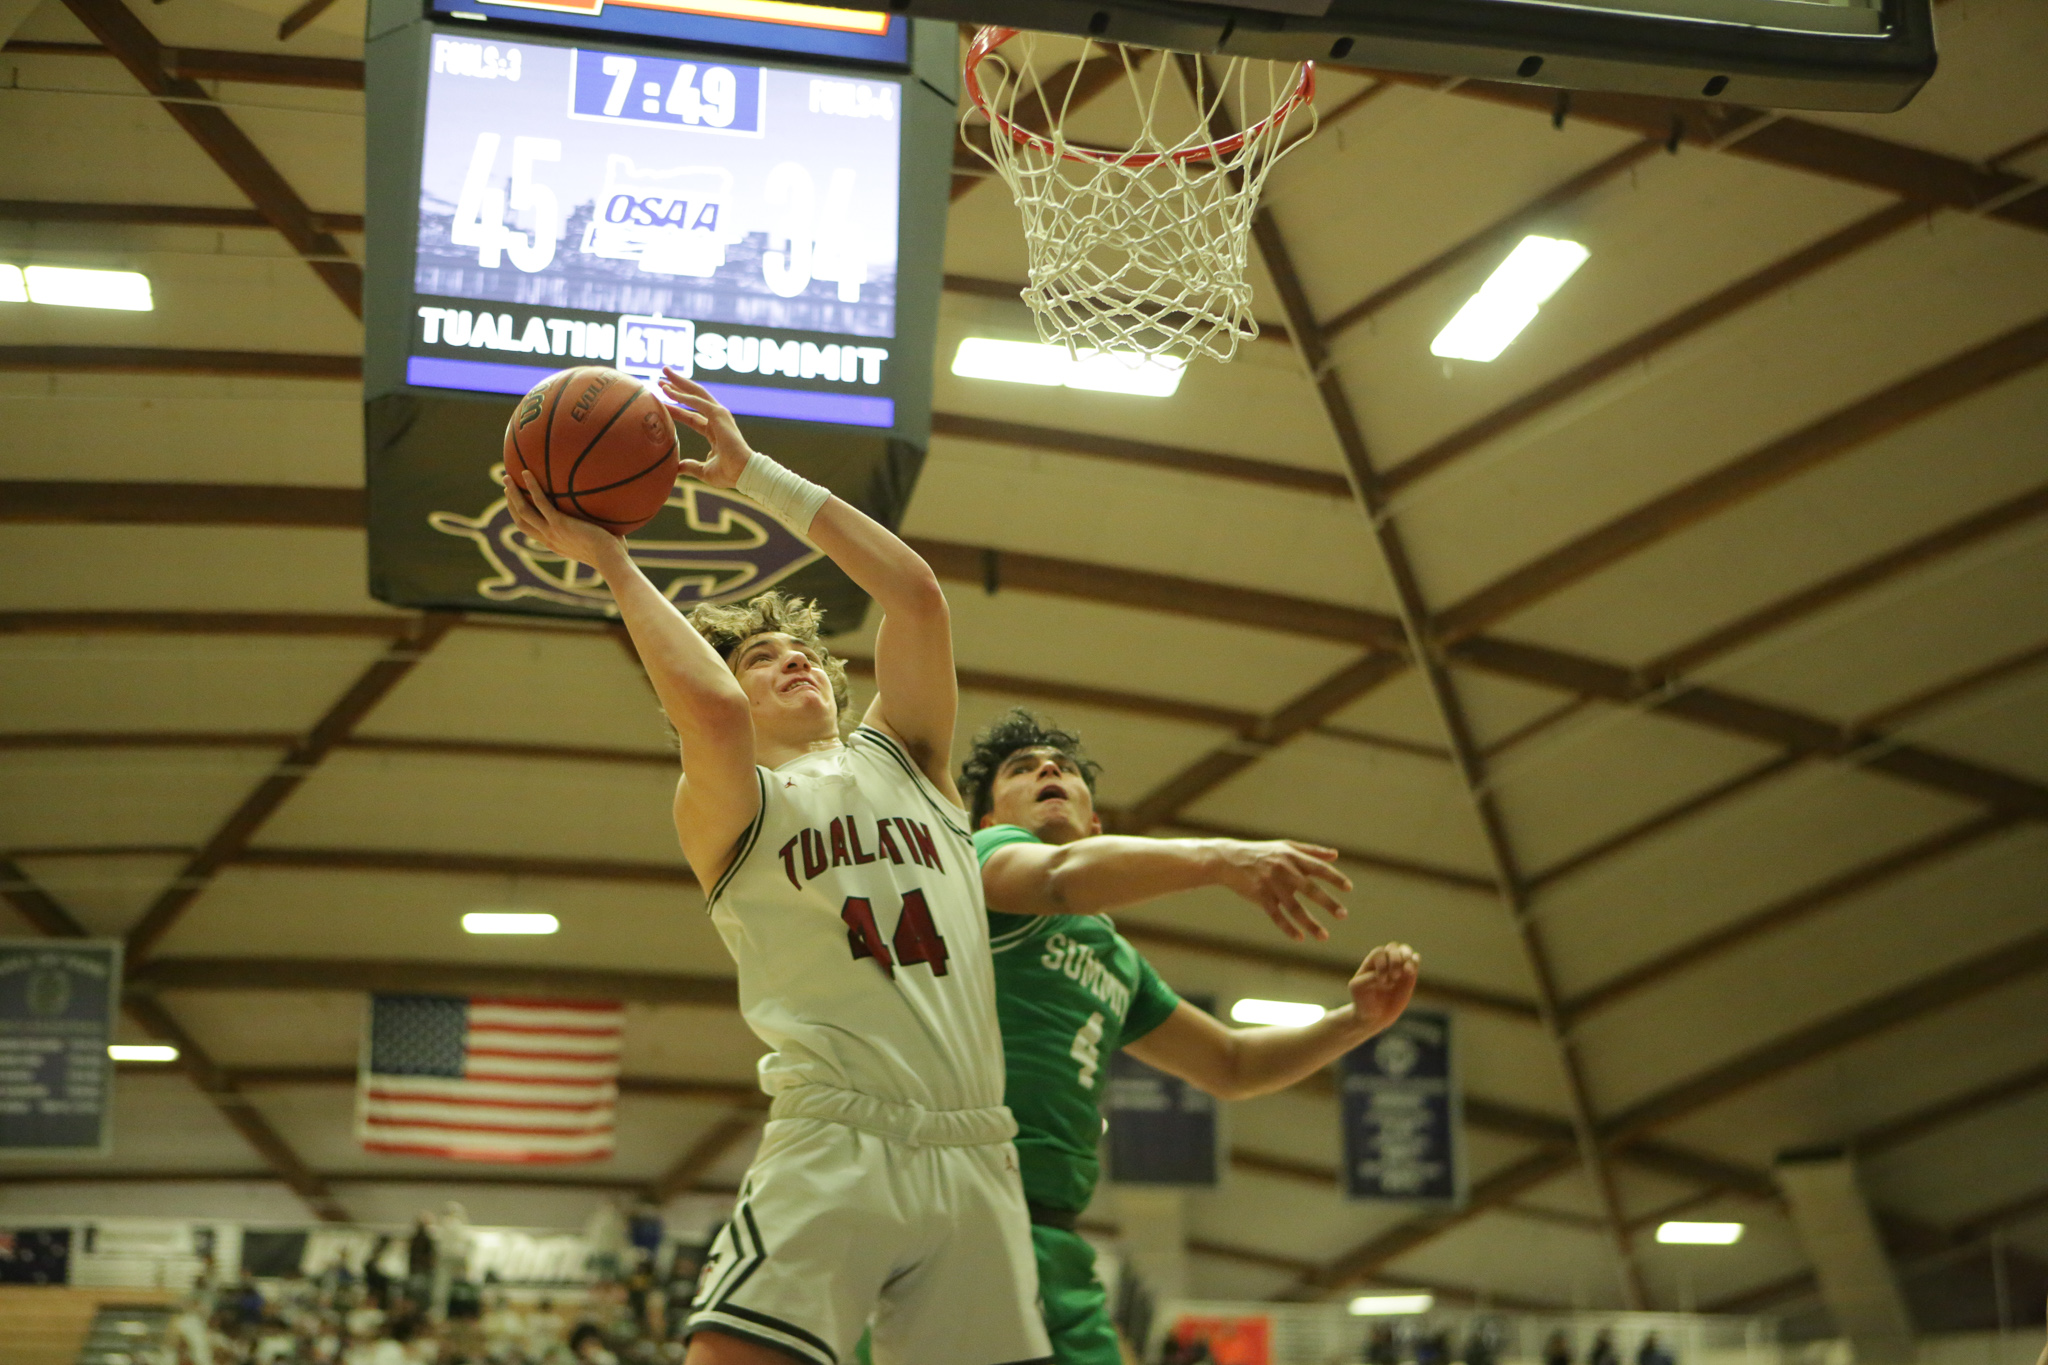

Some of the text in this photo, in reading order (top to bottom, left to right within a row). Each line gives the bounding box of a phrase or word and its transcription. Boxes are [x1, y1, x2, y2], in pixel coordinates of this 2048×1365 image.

[602, 56, 737, 128] 7:49
[450, 132, 562, 274] 45
[604, 194, 720, 233] OSAA
[762, 161, 868, 304] 34
[418, 306, 615, 361] TUALATIN
[693, 332, 889, 385] SUMMIT
[778, 814, 947, 892] TUALTIN
[841, 888, 950, 981] 44
[1070, 1011, 1104, 1090] 4
